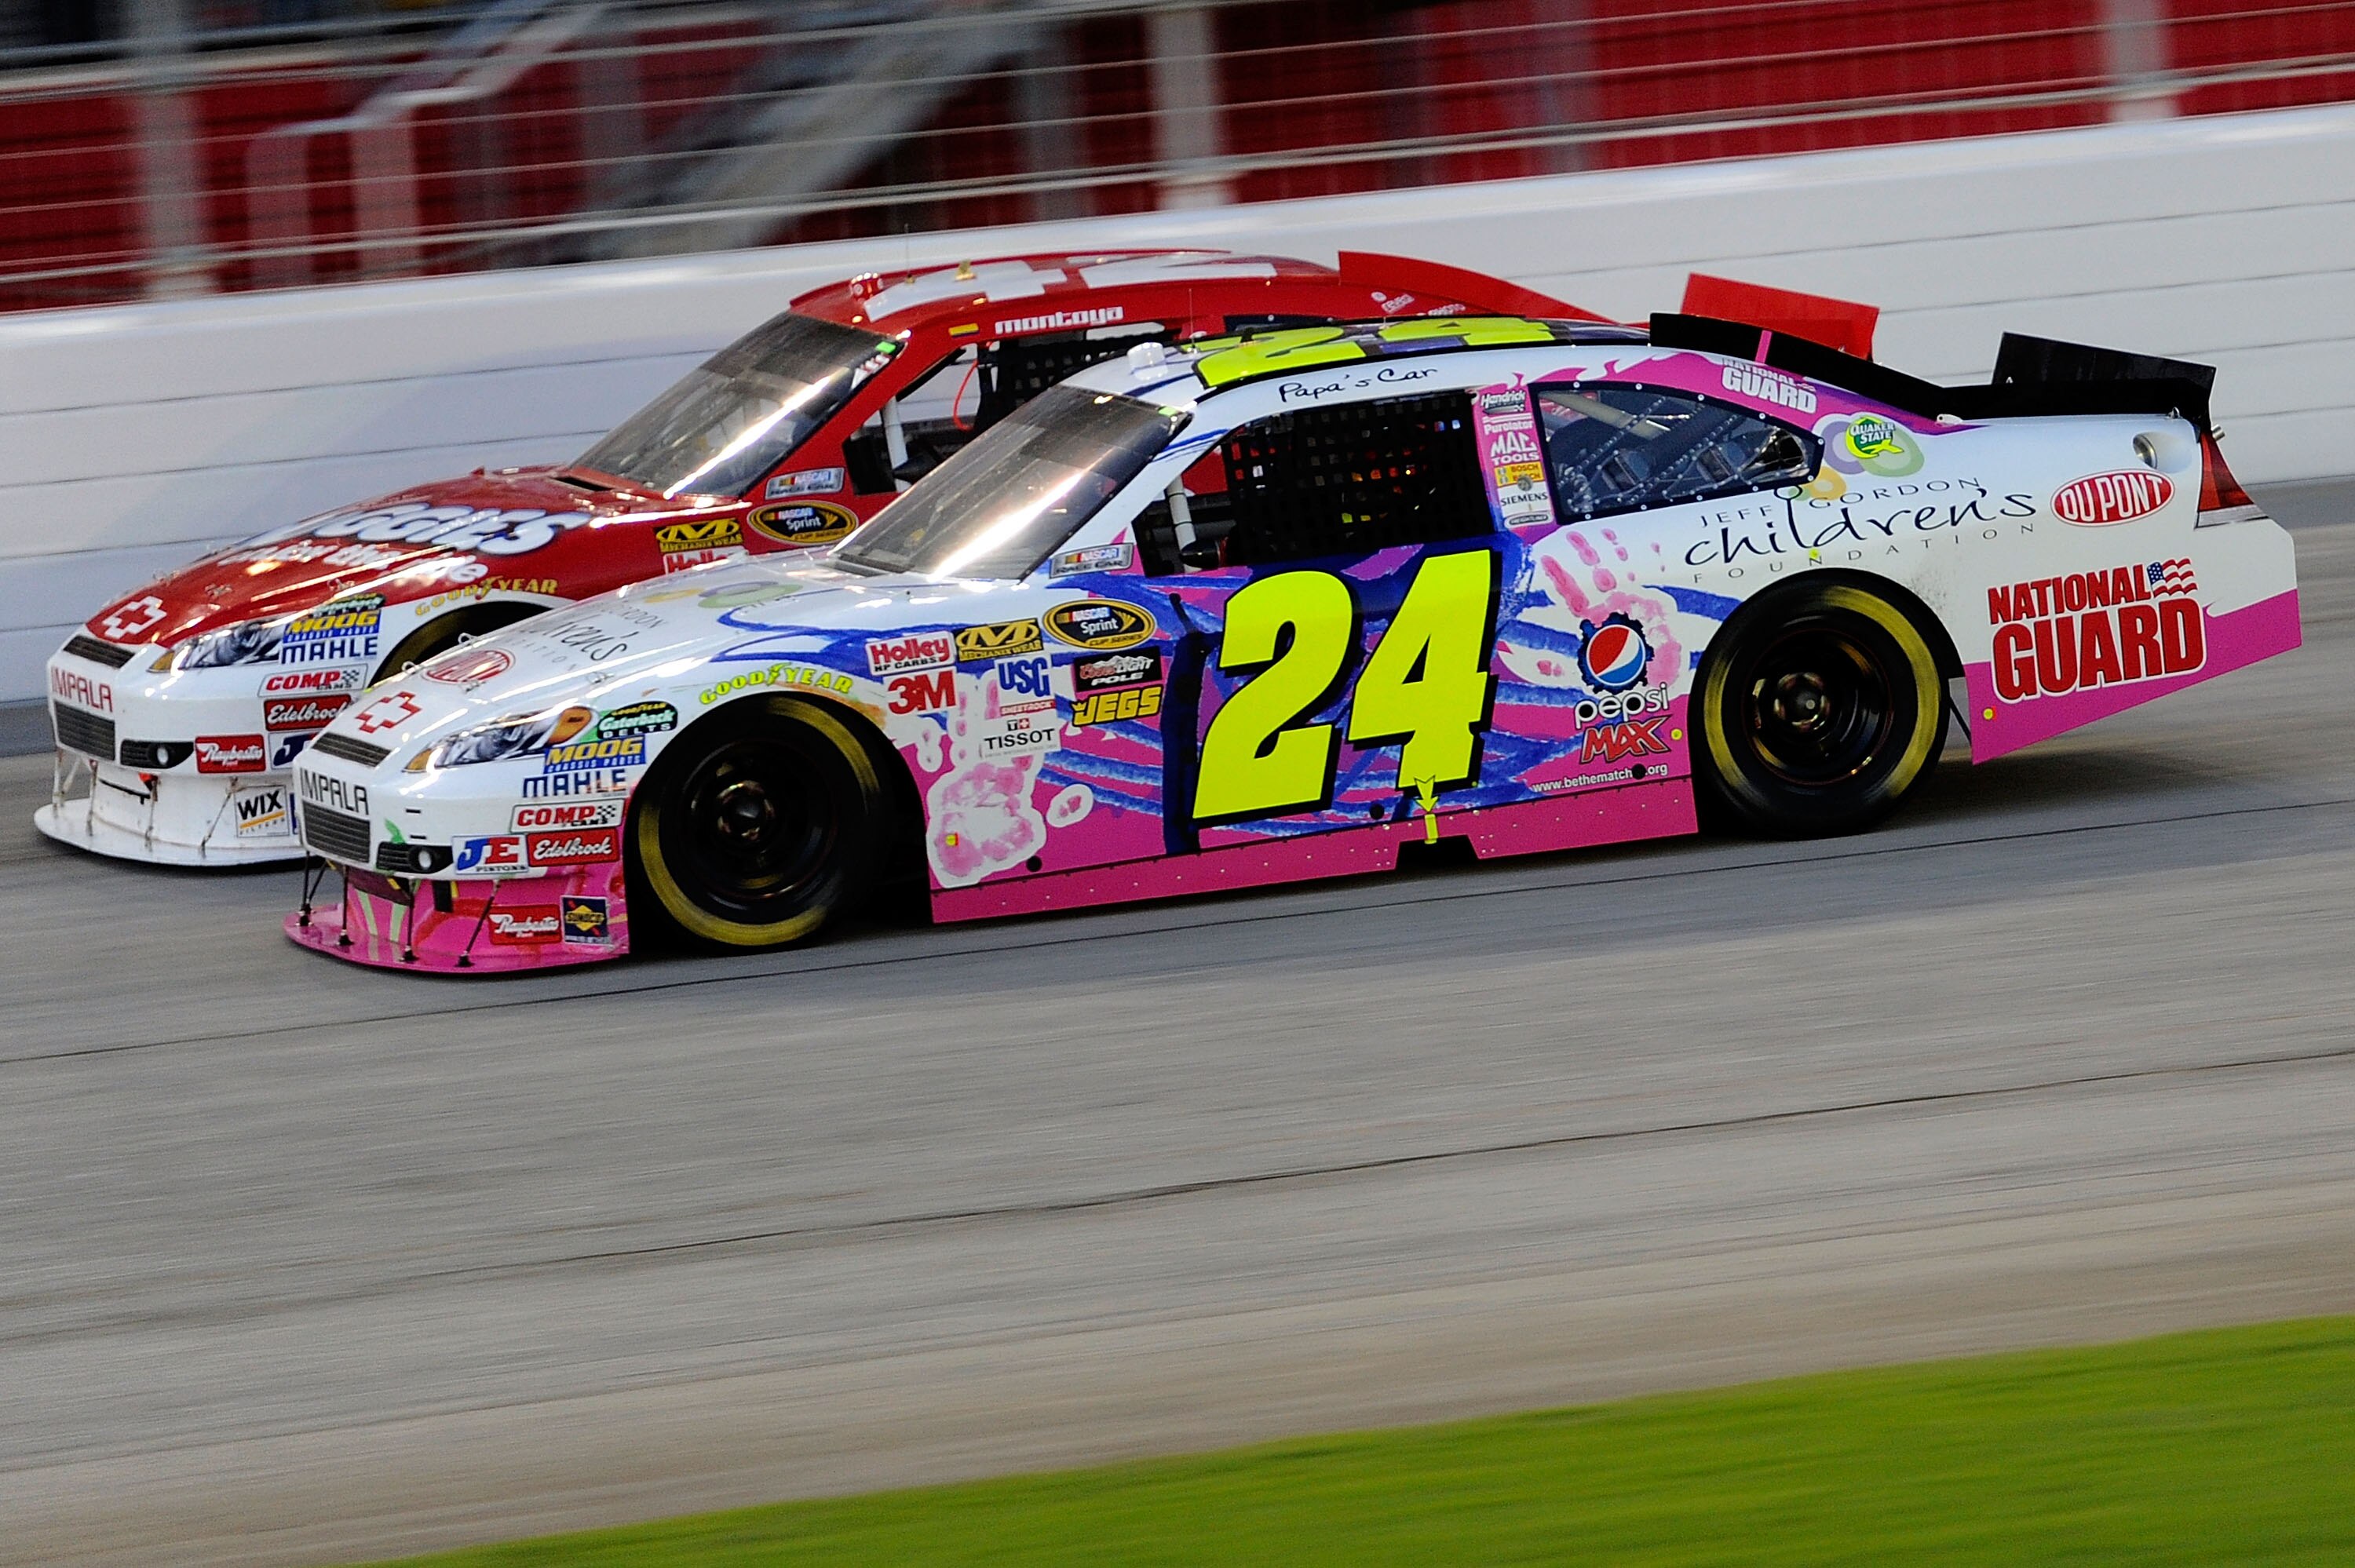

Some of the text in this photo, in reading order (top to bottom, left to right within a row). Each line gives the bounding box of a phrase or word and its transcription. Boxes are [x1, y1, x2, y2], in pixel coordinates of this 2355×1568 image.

[994, 306, 1124, 335] montoya
[1278, 368, 1438, 403] Papa's Car
[1722, 358, 1798, 386] NATIONAL
[1481, 390, 1526, 409] Hendrick
[1722, 366, 1817, 414] GUARD
[1849, 421, 1896, 436] QUAKER
[1860, 432, 1893, 444] STATE
[1491, 431, 1539, 457] MAC
[1492, 452, 1541, 466] TOOLS
[1510, 464, 1539, 472] BOSCH
[1500, 491, 1548, 506] SIEMENS
[1700, 477, 1981, 527] JEFF GORDON
[786, 516, 822, 531] Sprint
[1685, 484, 2037, 565] children's
[1080, 548, 1119, 563] NASCAR
[1693, 523, 2035, 584] FOUNDATION
[1987, 564, 2151, 625] NATIONAL
[286, 611, 380, 634] MOOG
[1072, 607, 1110, 622] NASCAR
[1079, 618, 1119, 635] Sprint
[281, 636, 378, 664] MAHLE
[871, 638, 950, 664] Holley
[959, 640, 1042, 661] MECHANIX WEAR
[1992, 597, 2204, 701] GUARD
[874, 658, 937, 673] HP CARBS
[998, 658, 1050, 698] USG
[1091, 673, 1144, 686] POLE
[51, 666, 113, 713] IMPALA
[265, 671, 341, 691] COMP
[699, 664, 853, 705] GOODYEAR
[888, 670, 956, 714] 3M
[1192, 549, 1491, 819] 24
[1073, 686, 1162, 725] JEGS
[1575, 682, 1669, 729] pepsi
[603, 723, 671, 738] BELTS
[984, 728, 1055, 749] TISSOT
[1580, 714, 1673, 764] MAX
[546, 736, 644, 765] MOOG
[300, 766, 369, 815] IMPALA
[522, 768, 626, 799] MAHLE
[237, 789, 283, 820] WIX
[517, 805, 596, 826] COMP
[457, 837, 520, 870] JE
[533, 836, 612, 860] Edelbrock
